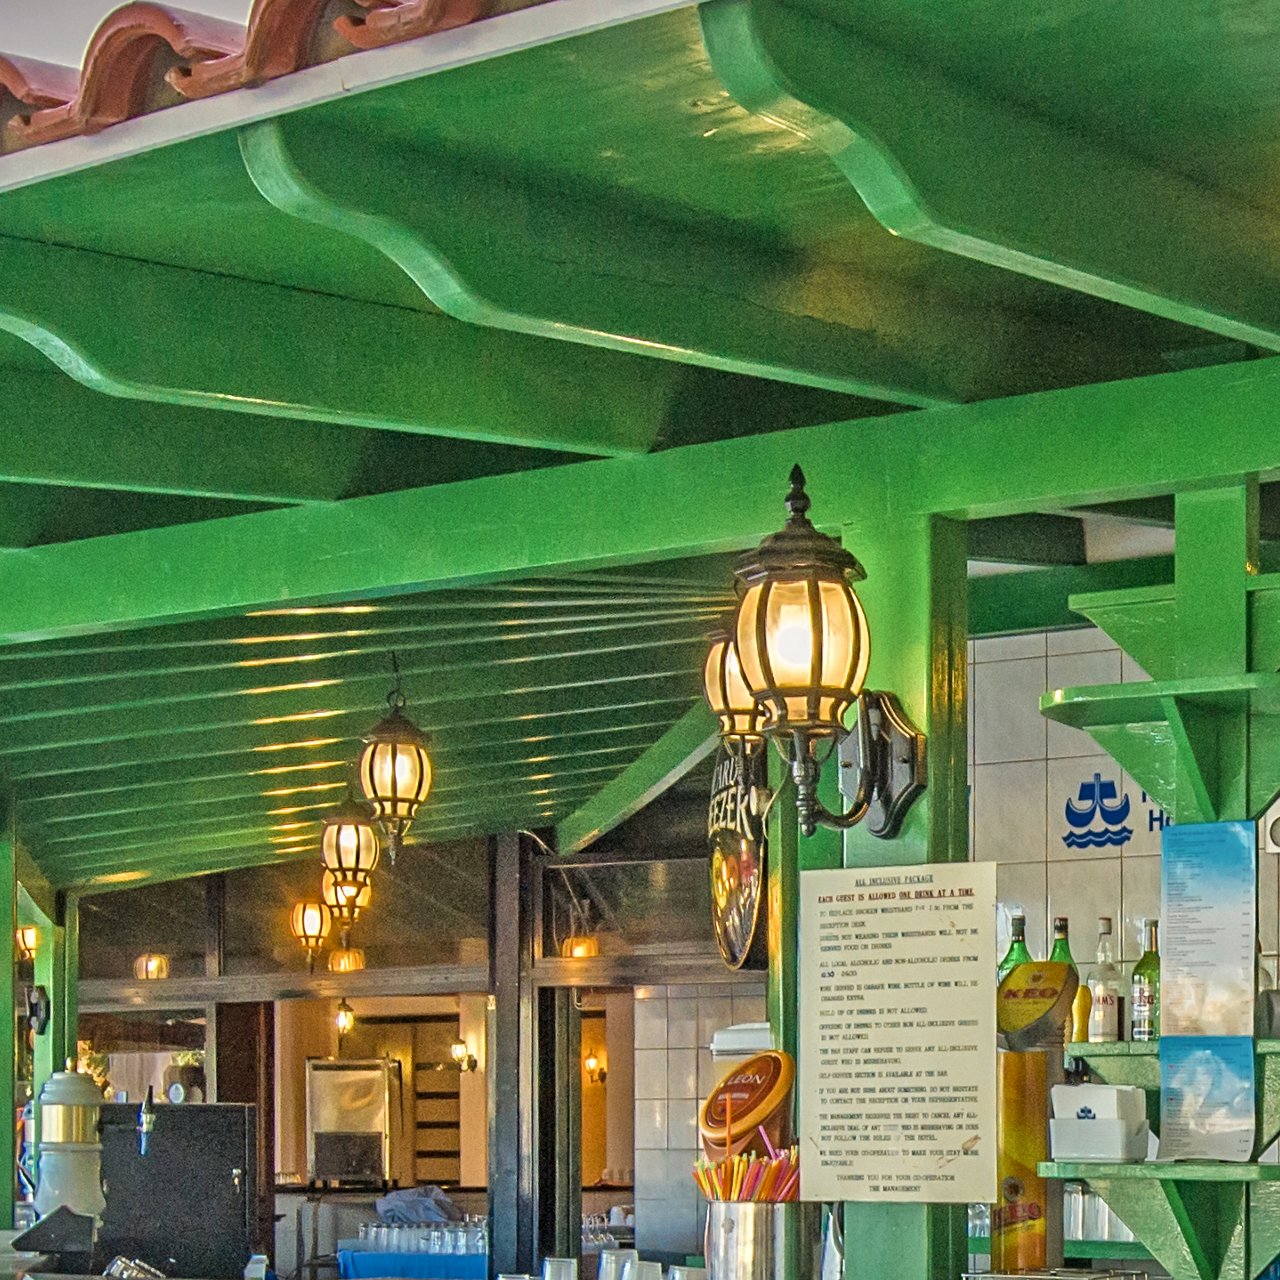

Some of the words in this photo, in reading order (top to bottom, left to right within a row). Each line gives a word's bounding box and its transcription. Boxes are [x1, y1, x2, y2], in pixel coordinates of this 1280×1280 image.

[870, 877, 901, 886] INCLUSIVE
[905, 875, 934, 883] PACKAGE
[868, 892, 896, 900] ALLOWED
[899, 891, 911, 899] ONE
[915, 890, 934, 898] DRINK
[937, 889, 946, 897] AT
[958, 888, 974, 896] TIME
[1004, 988, 1058, 999] KEO
